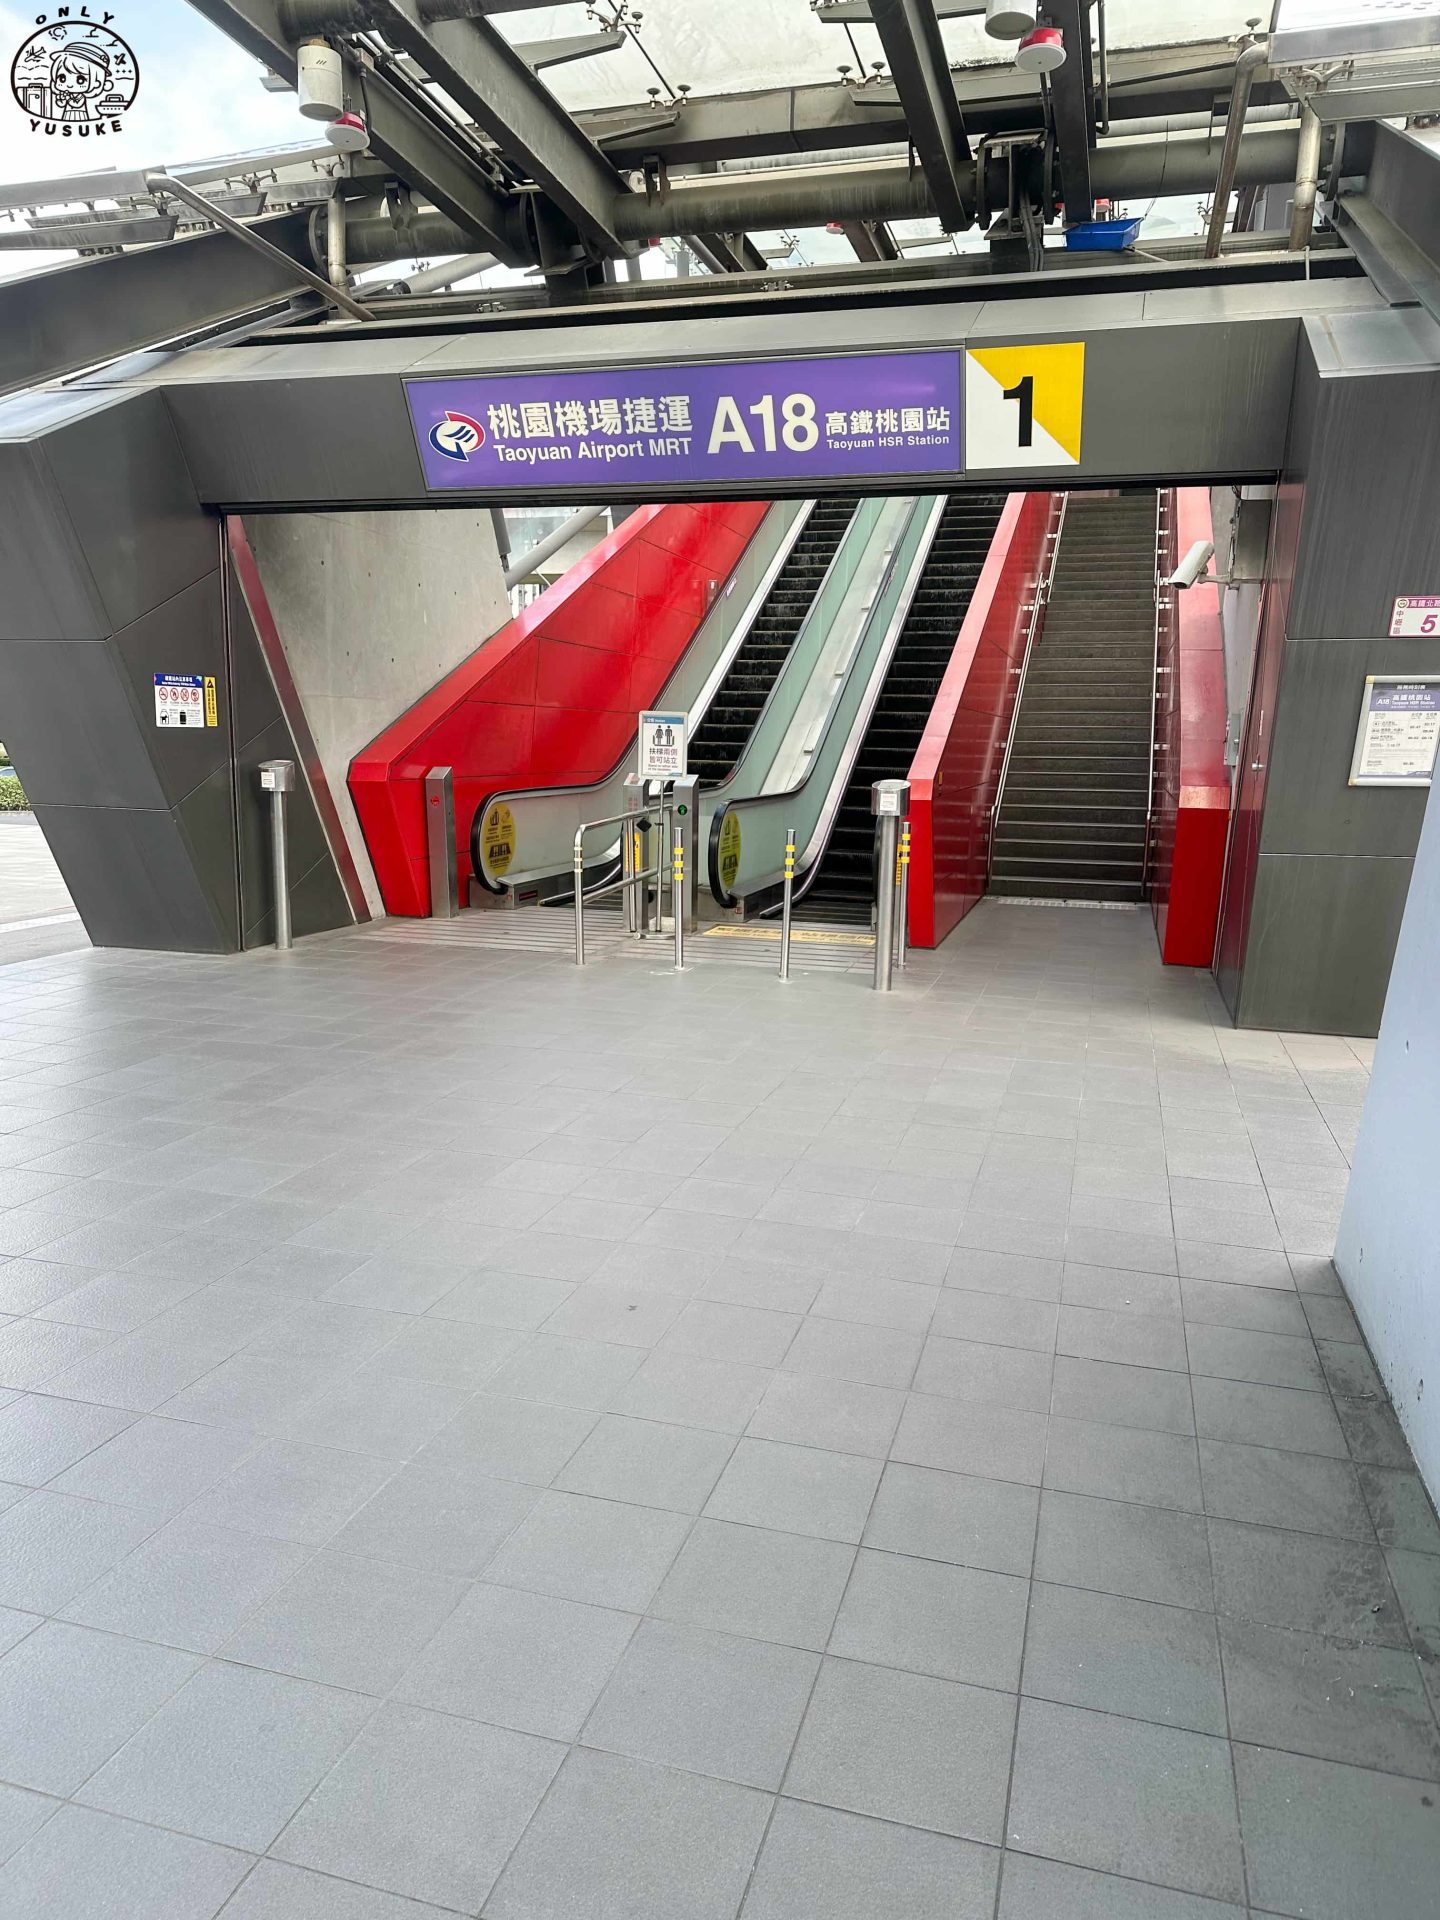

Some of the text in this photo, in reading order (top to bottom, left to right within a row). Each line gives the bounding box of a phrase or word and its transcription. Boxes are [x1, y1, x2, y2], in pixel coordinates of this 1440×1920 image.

[487, 395, 693, 440] 桃園機場捷運
[707, 393, 820, 454] A18
[825, 406, 951, 436] 高鐵桃園站
[1002, 376, 1034, 447] 1
[492, 437, 692, 465] Taoyuan Airport MRT
[826, 434, 950, 451] Taoyuan HSR Station
[1420, 614, 1438, 633] 5
[1376, 697, 1391, 705] A18
[649, 756, 678, 765] 皆可站立
